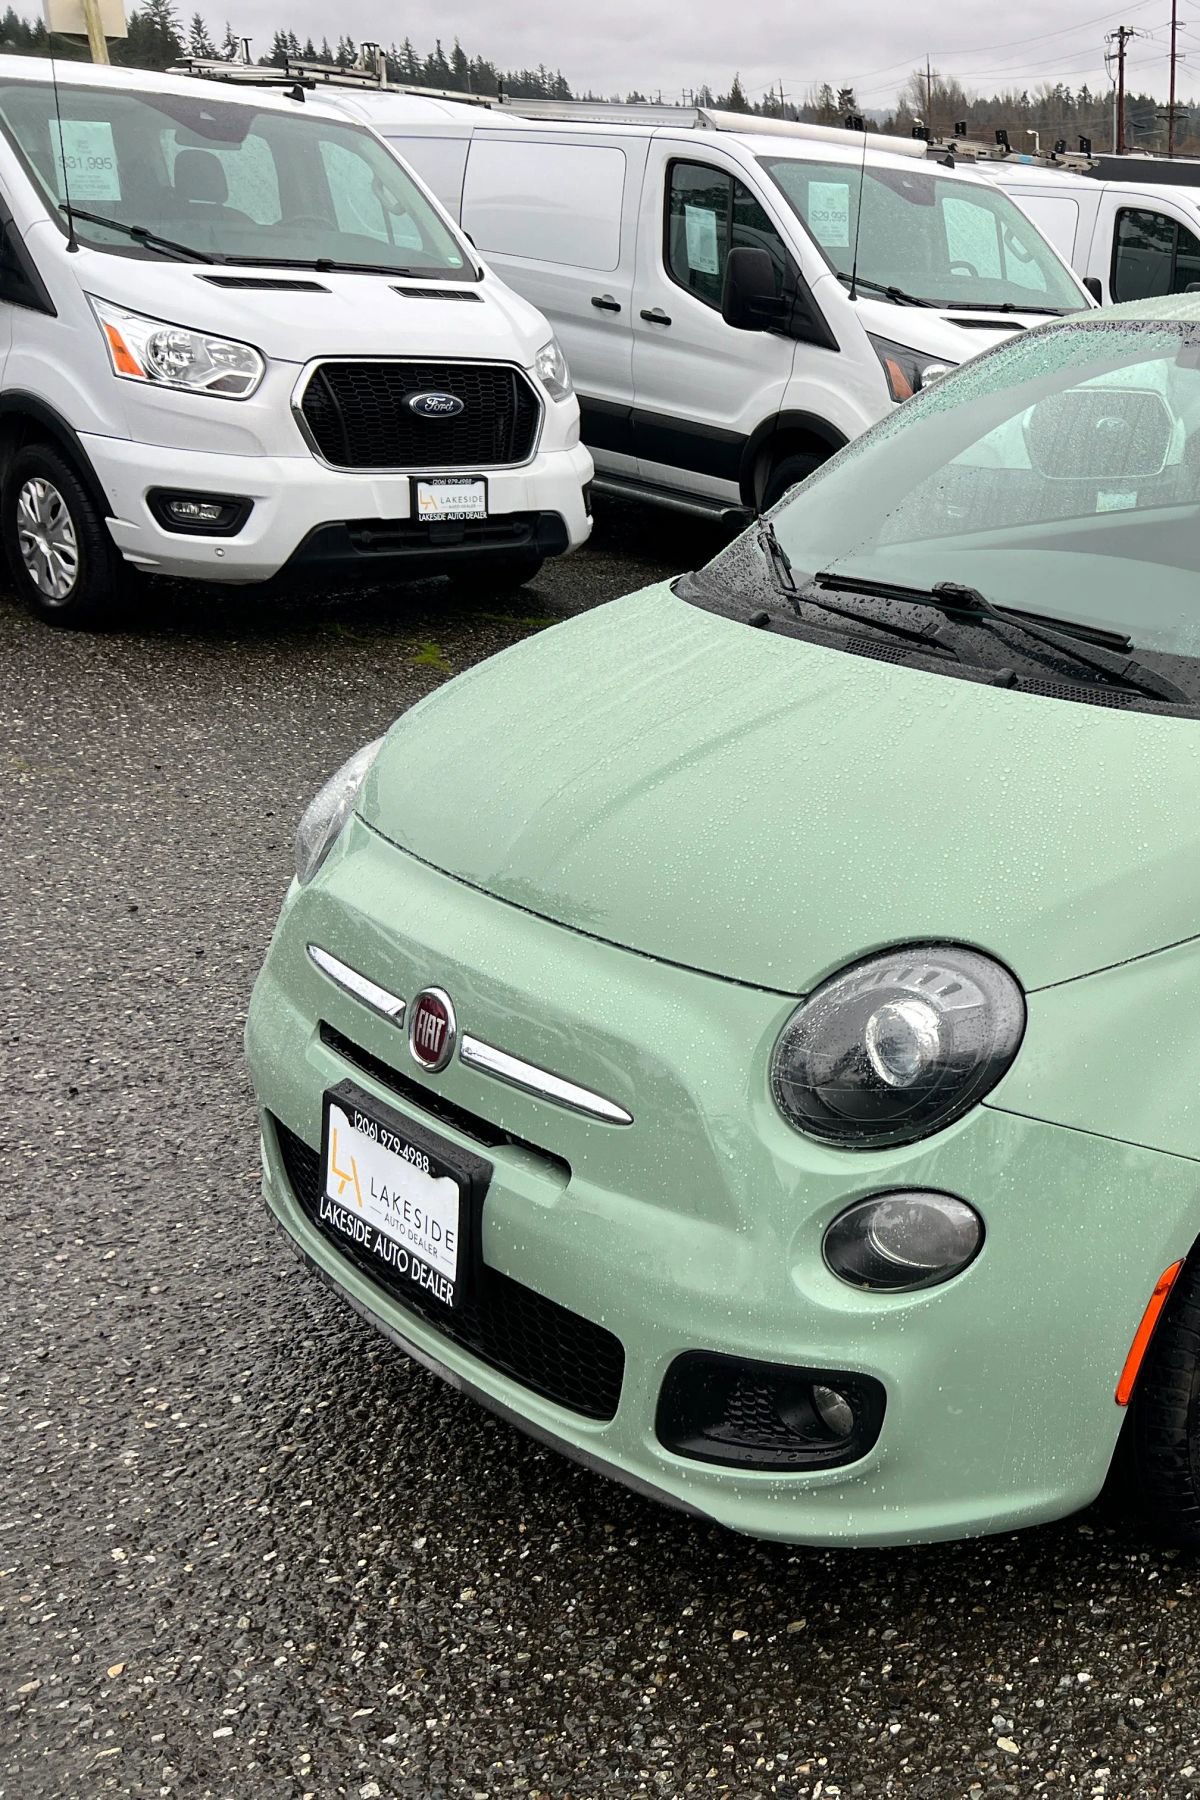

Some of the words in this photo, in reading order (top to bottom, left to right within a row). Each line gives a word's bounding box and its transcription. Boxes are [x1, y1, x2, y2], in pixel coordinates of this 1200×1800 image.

[58, 155, 113, 171] $31,995
[424, 397, 454, 411] Ford
[419, 512, 446, 521] LAKESIDE
[447, 512, 465, 520] AUTO
[465, 511, 488, 520] DEALER
[440, 495, 484, 504] LAKESIDE
[416, 1008, 446, 1053] FIAT
[354, 1110, 378, 1141] (206)
[380, 1130, 430, 1174] 979-4988
[370, 1176, 455, 1252] LAKESIDE
[384, 1212, 406, 1236] AUTO
[407, 1230, 438, 1259] DEALER
[319, 1196, 372, 1249] LAKESIDE
[373, 1234, 409, 1273] AUTO
[411, 1258, 454, 1308] DEALER
